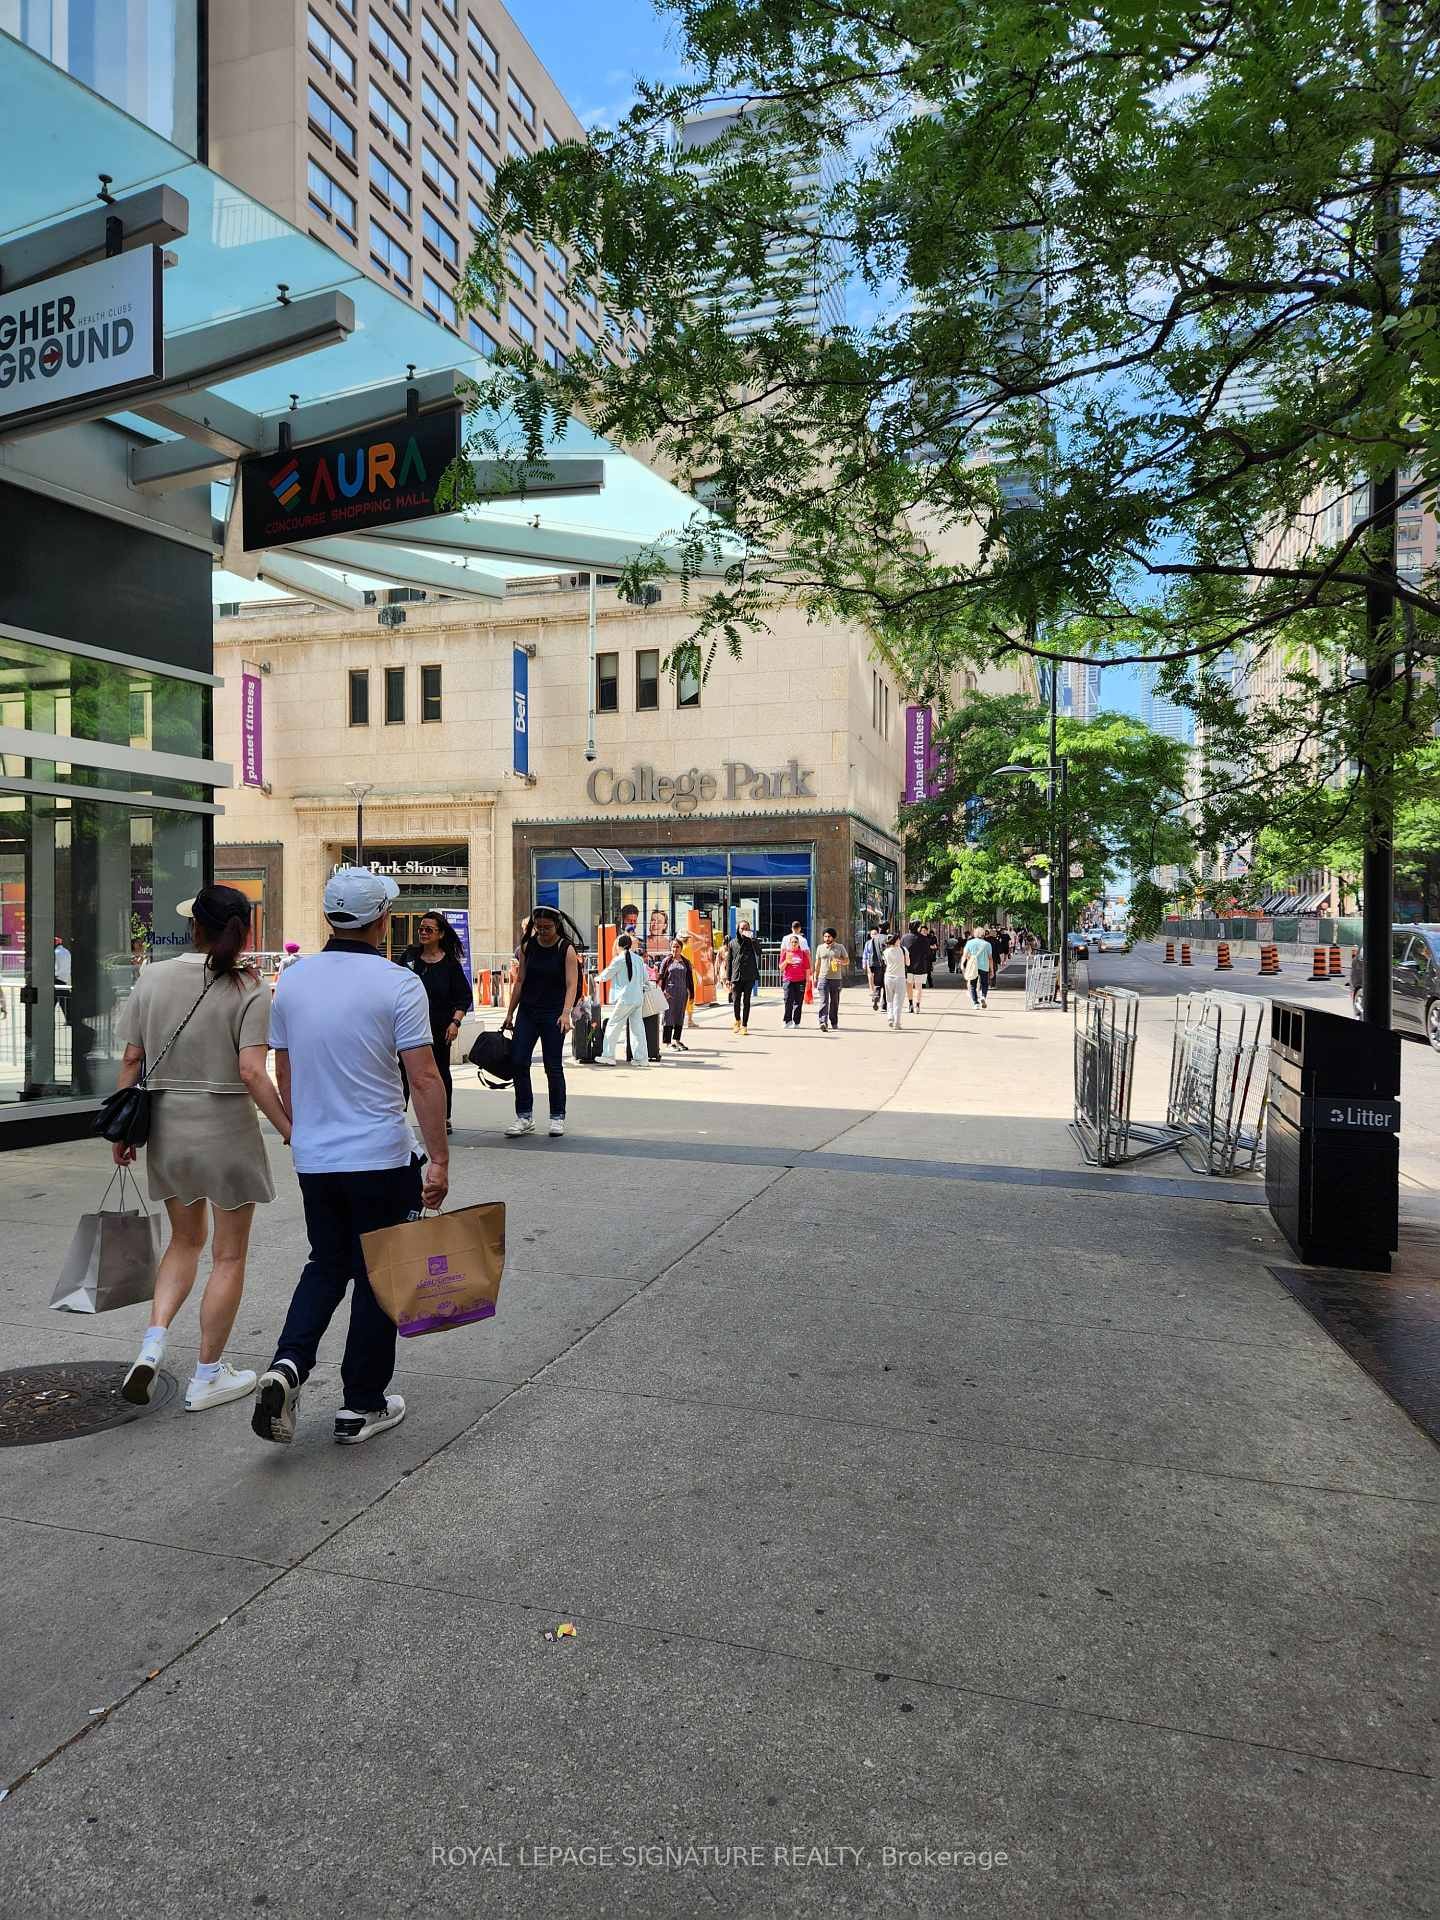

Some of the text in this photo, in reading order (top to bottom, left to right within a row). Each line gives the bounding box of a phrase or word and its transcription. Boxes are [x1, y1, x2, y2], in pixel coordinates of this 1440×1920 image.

[78, 303, 133, 326] HEALTH CLUBS
[0, 318, 134, 388] GROUND
[309, 435, 428, 504] AURA
[266, 491, 431, 535] CONCOURSE SHOPPING MALL
[245, 681, 258, 781] planet fitness
[514, 690, 526, 733] Bell
[913, 711, 926, 800] planet fitness
[587, 759, 818, 812] College Park
[370, 860, 402, 875] Park
[405, 860, 449, 877] Shops
[661, 861, 684, 875] Bell
[1347, 1107, 1393, 1127] Litter
